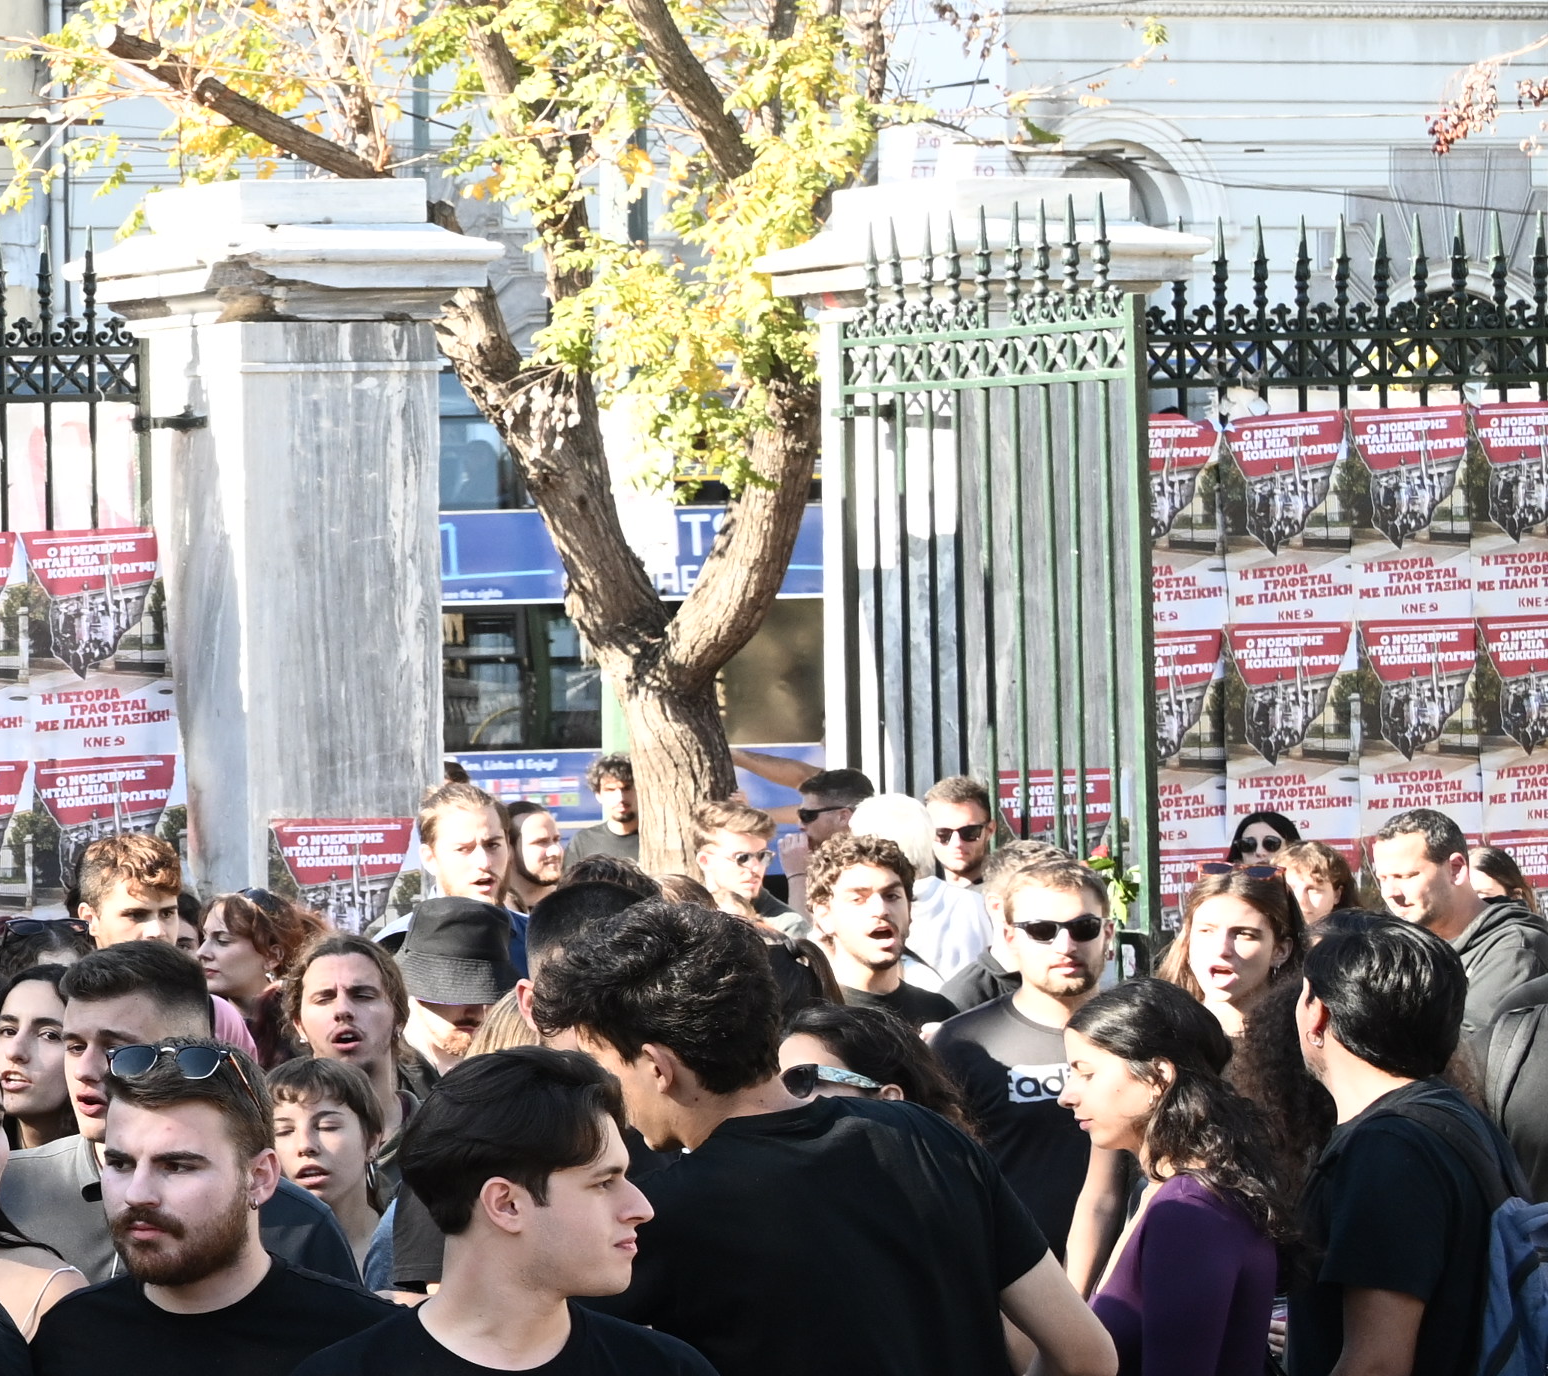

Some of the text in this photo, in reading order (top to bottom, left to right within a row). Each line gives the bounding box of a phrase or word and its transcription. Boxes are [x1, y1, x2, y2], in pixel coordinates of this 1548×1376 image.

[1246, 636, 1323, 648] Ο ΝΟΕΜΒΡΗΣ
[1235, 648, 1291, 659] ΗΤΑΝ ΜΙΑ
[1245, 655, 1343, 669] ΚΟΚΚΙΝΗ ΡΩΓΜΗ
[1238, 774, 1306, 789] Η ΙΣΤΟΡΙΑ
[1260, 785, 1326, 799] ΓΡΑΦΕΤΑΙ
[1234, 797, 1353, 815] ΜΕ ΠΑΛΗ ΤΑΞΙΚΗ!
